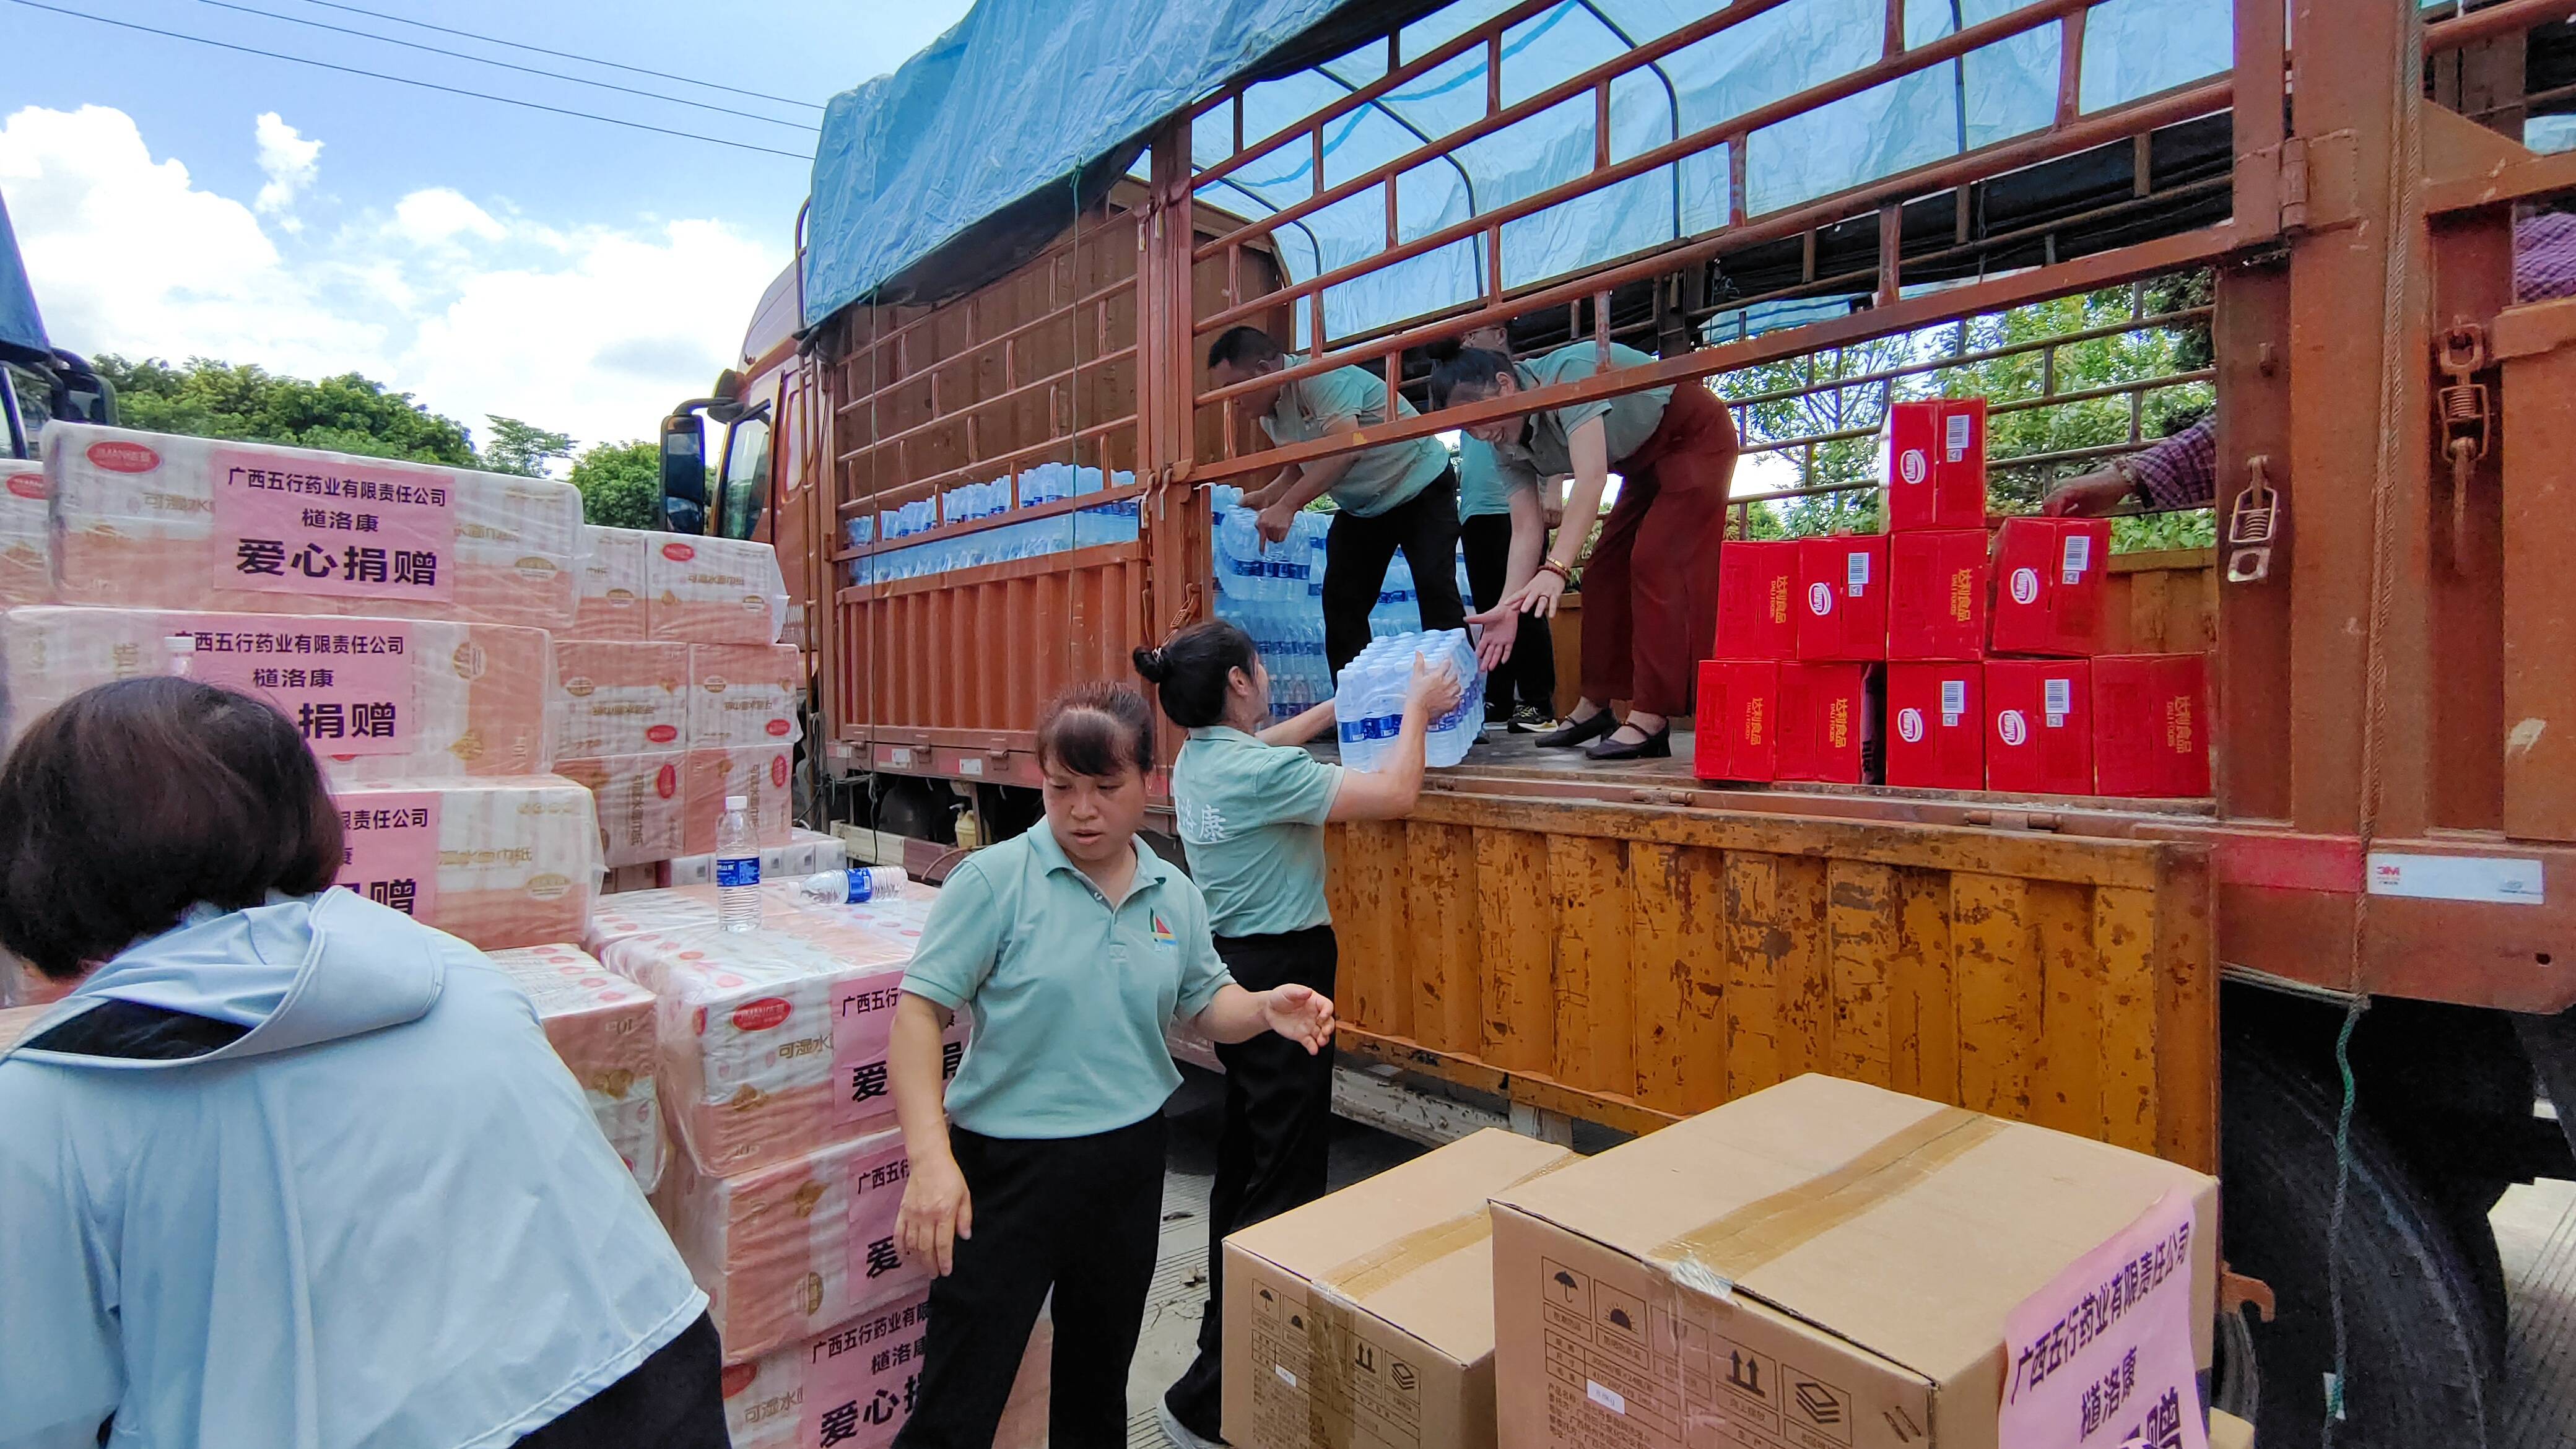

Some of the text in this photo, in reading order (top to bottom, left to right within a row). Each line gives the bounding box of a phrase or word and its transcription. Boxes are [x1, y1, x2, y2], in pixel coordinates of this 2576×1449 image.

[228, 466, 446, 508] 广西五行药业有限责任公司
[237, 537, 437, 586] 爱心捐赠
[1775, 575, 1789, 624] 达利食品
[1957, 568, 1973, 622] 达利食品
[1750, 697, 1764, 746] 达利食品
[1834, 698, 1848, 748] 达利食品
[2174, 695, 2192, 753] 达利食品
[2377, 866, 2400, 876] 3M
[779, 1034, 834, 1059] 可湿水
[2011, 1221, 2189, 1406] 广西五行药业有限责任公司
